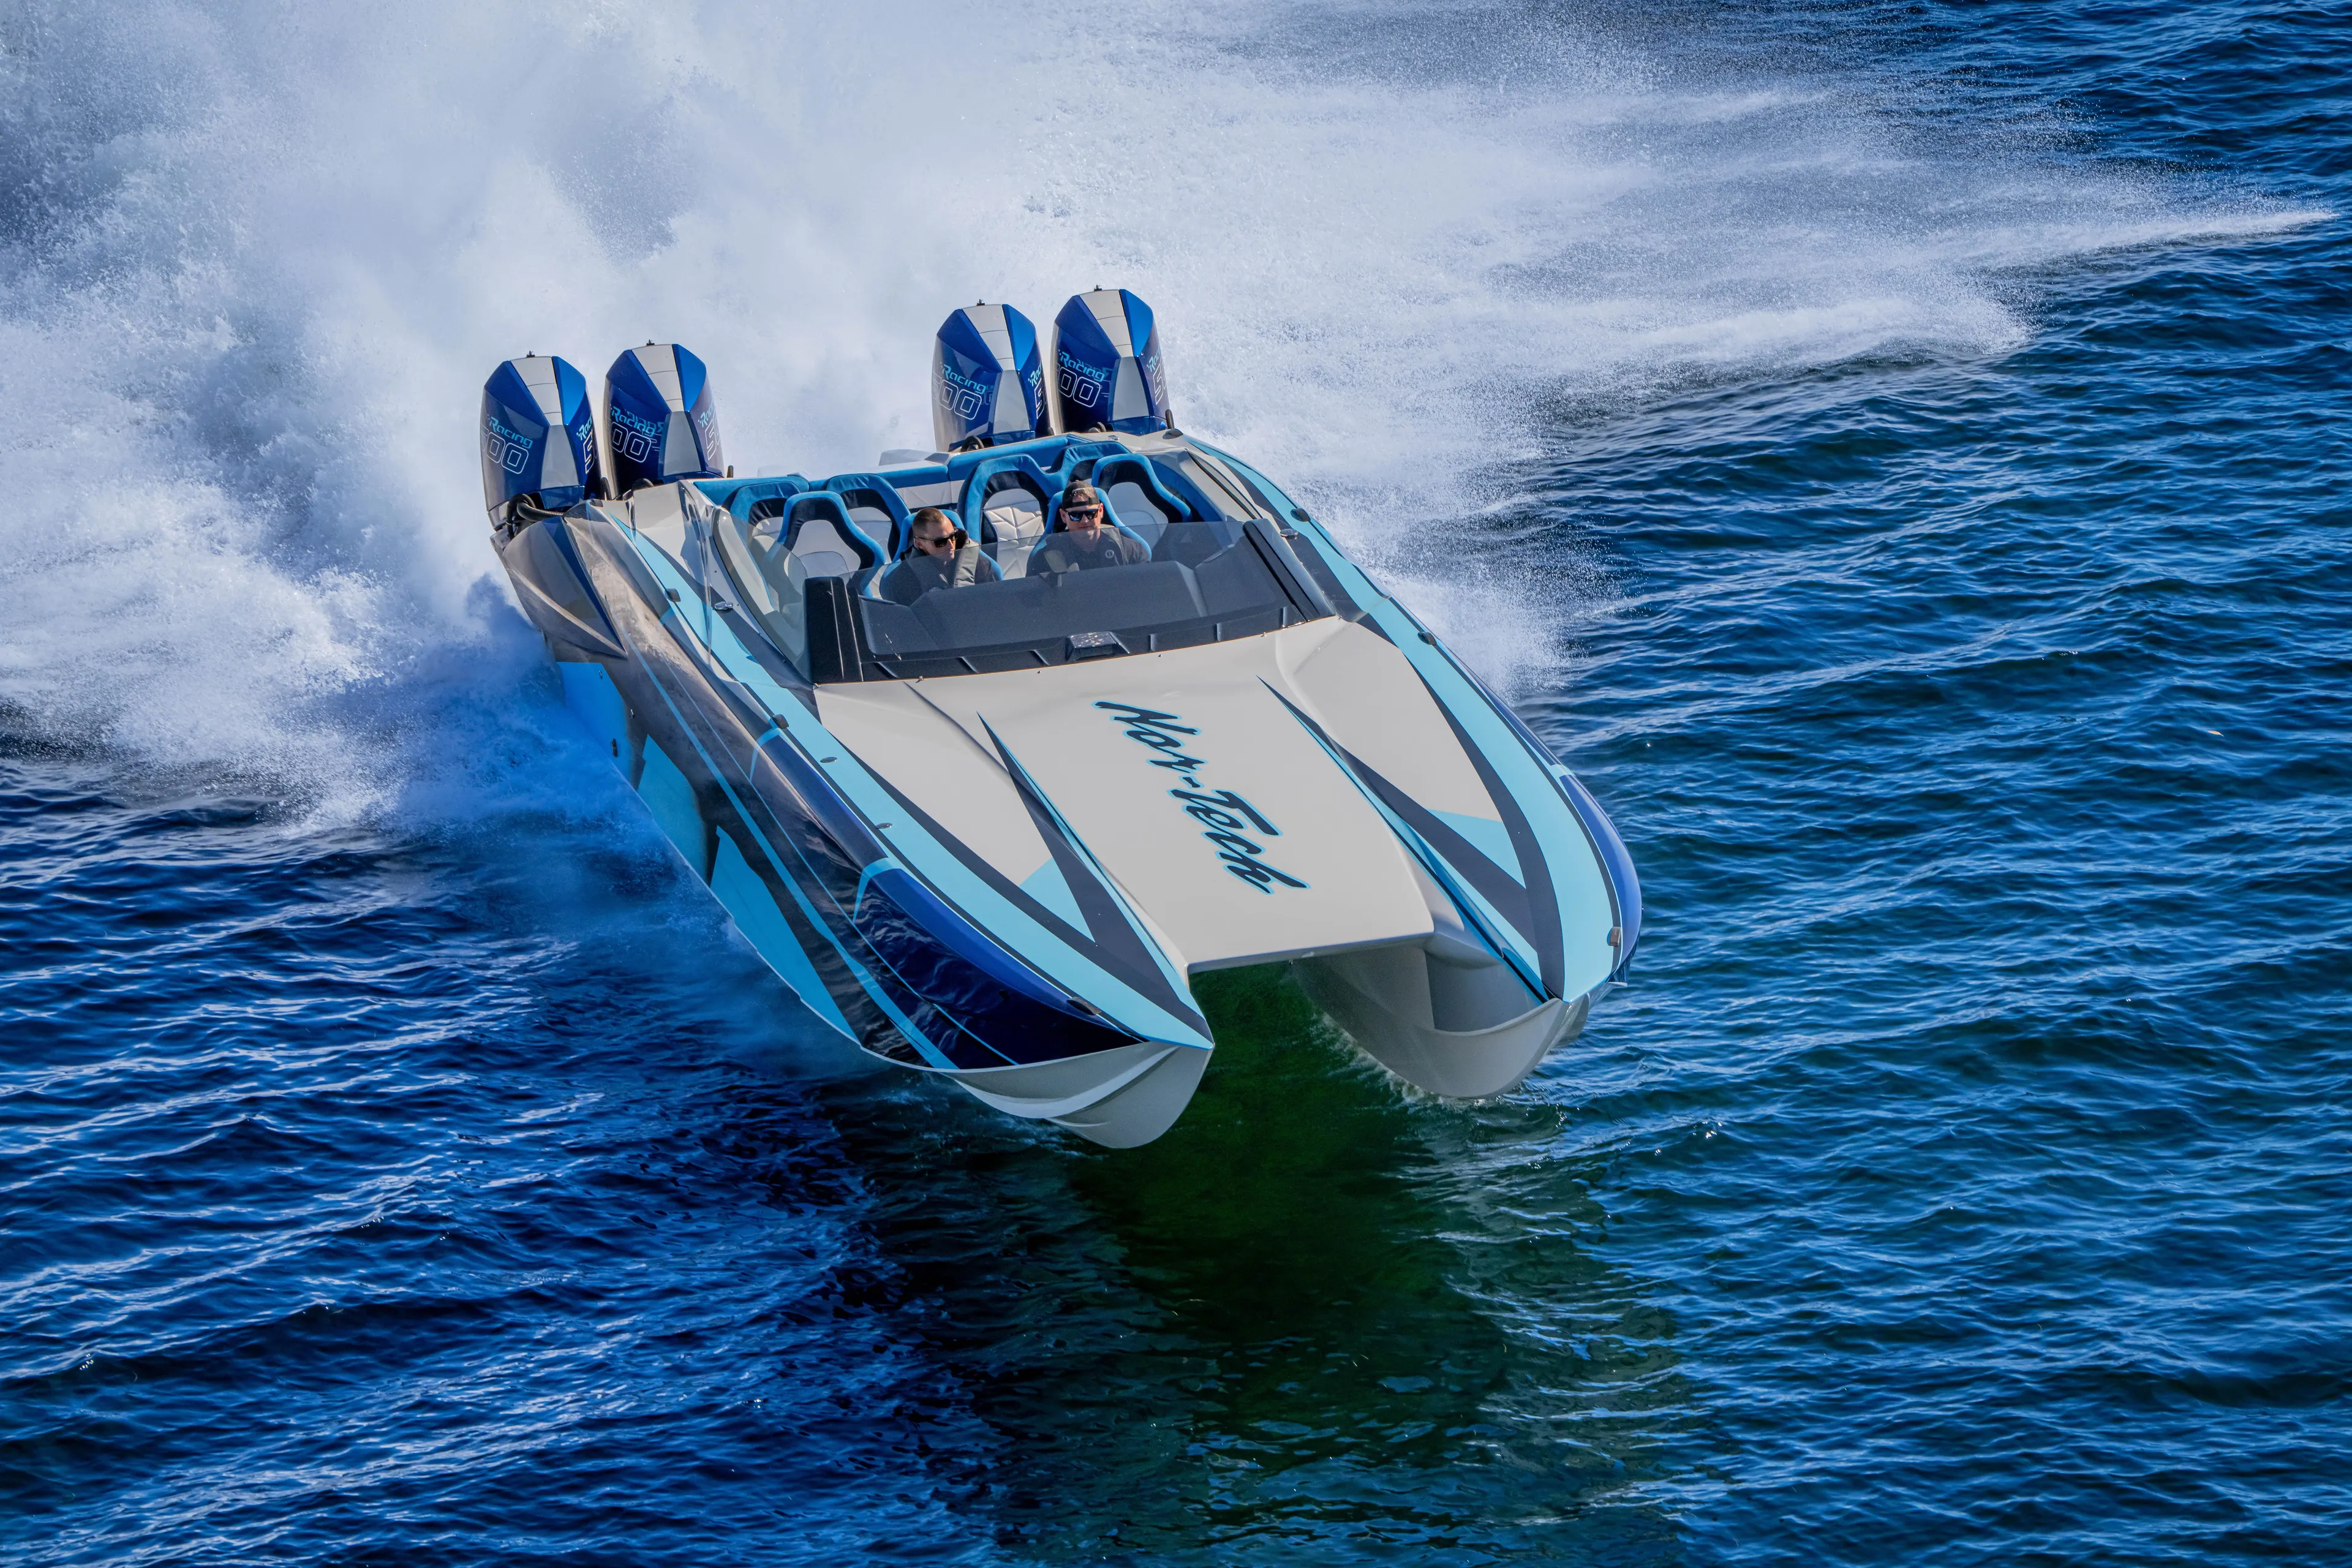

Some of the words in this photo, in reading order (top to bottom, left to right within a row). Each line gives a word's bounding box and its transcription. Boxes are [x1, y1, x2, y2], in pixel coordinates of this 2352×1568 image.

[942, 364, 987, 394] Racing
[1060, 352, 1105, 382] Racing
[489, 417, 533, 449] Racing
[611, 405, 655, 437] Racing
[1091, 701, 1311, 895] Nor-Tech
